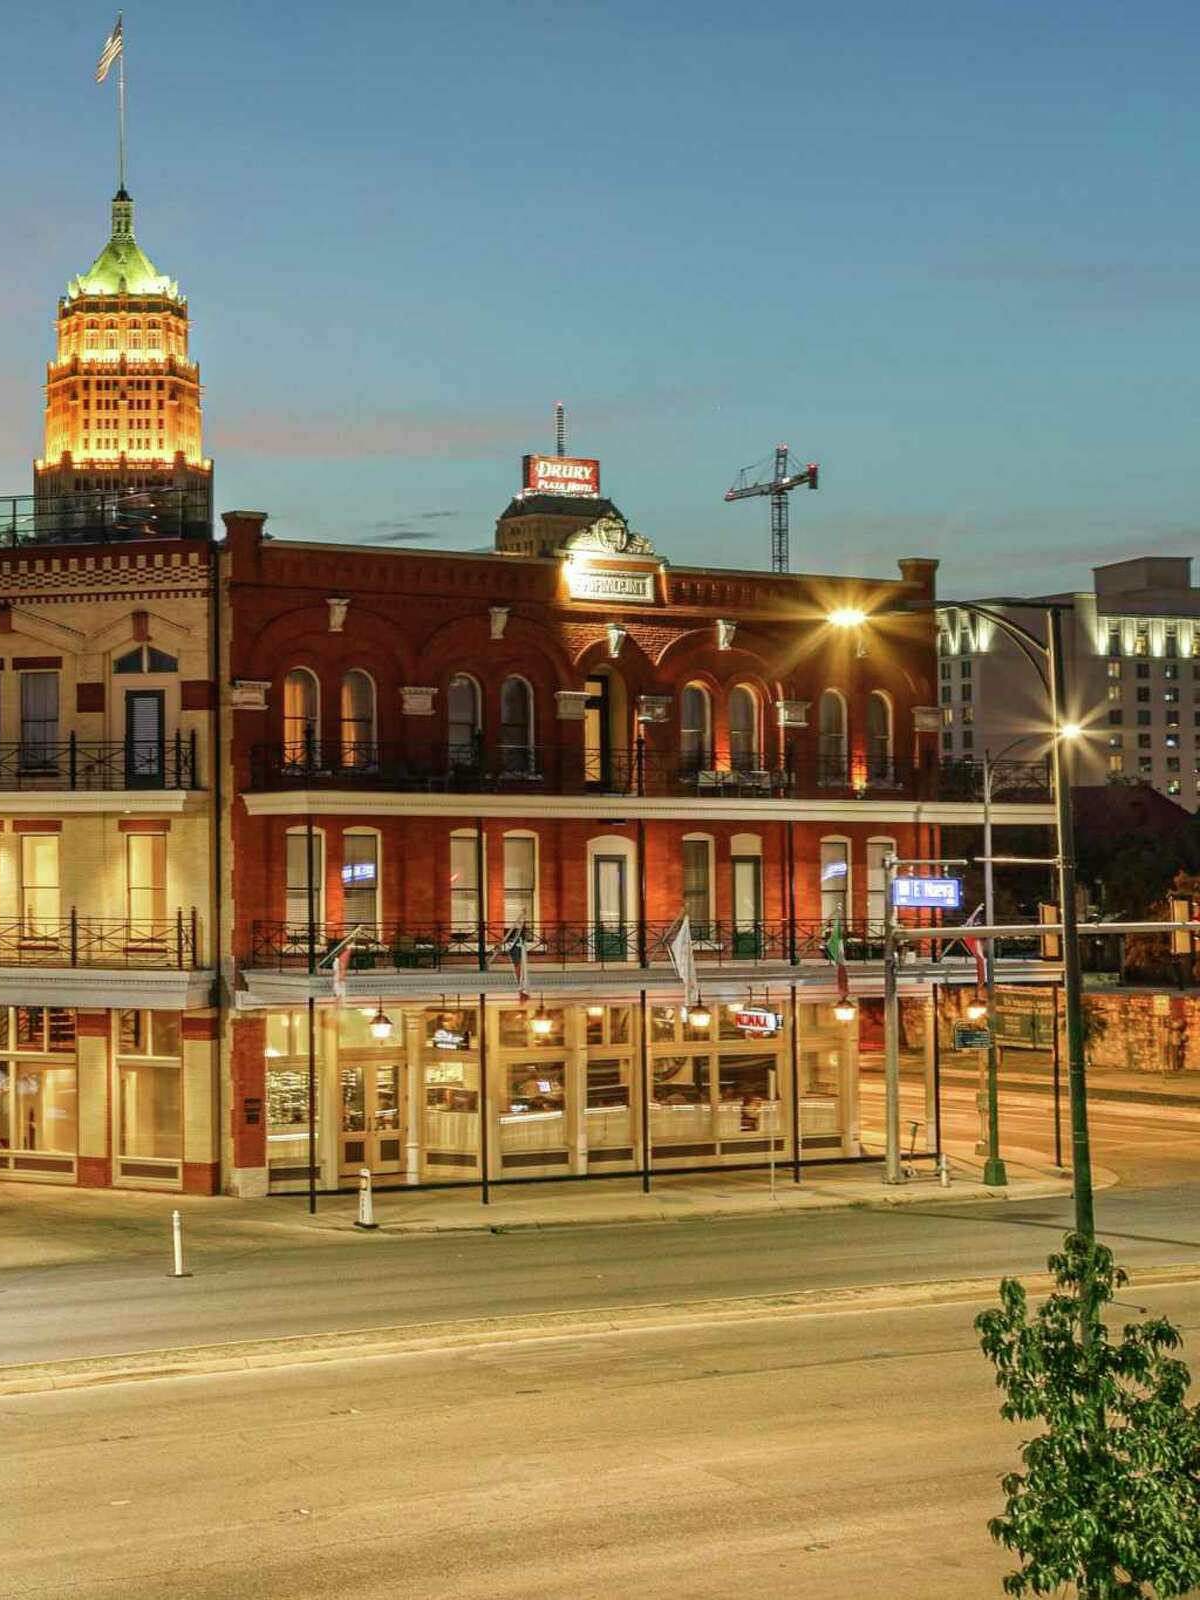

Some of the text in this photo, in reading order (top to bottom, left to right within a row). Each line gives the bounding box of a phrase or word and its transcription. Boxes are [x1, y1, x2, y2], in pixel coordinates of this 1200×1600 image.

[535, 460, 593, 480] DRURY
[537, 478, 593, 492] PLAZA HOTEL
